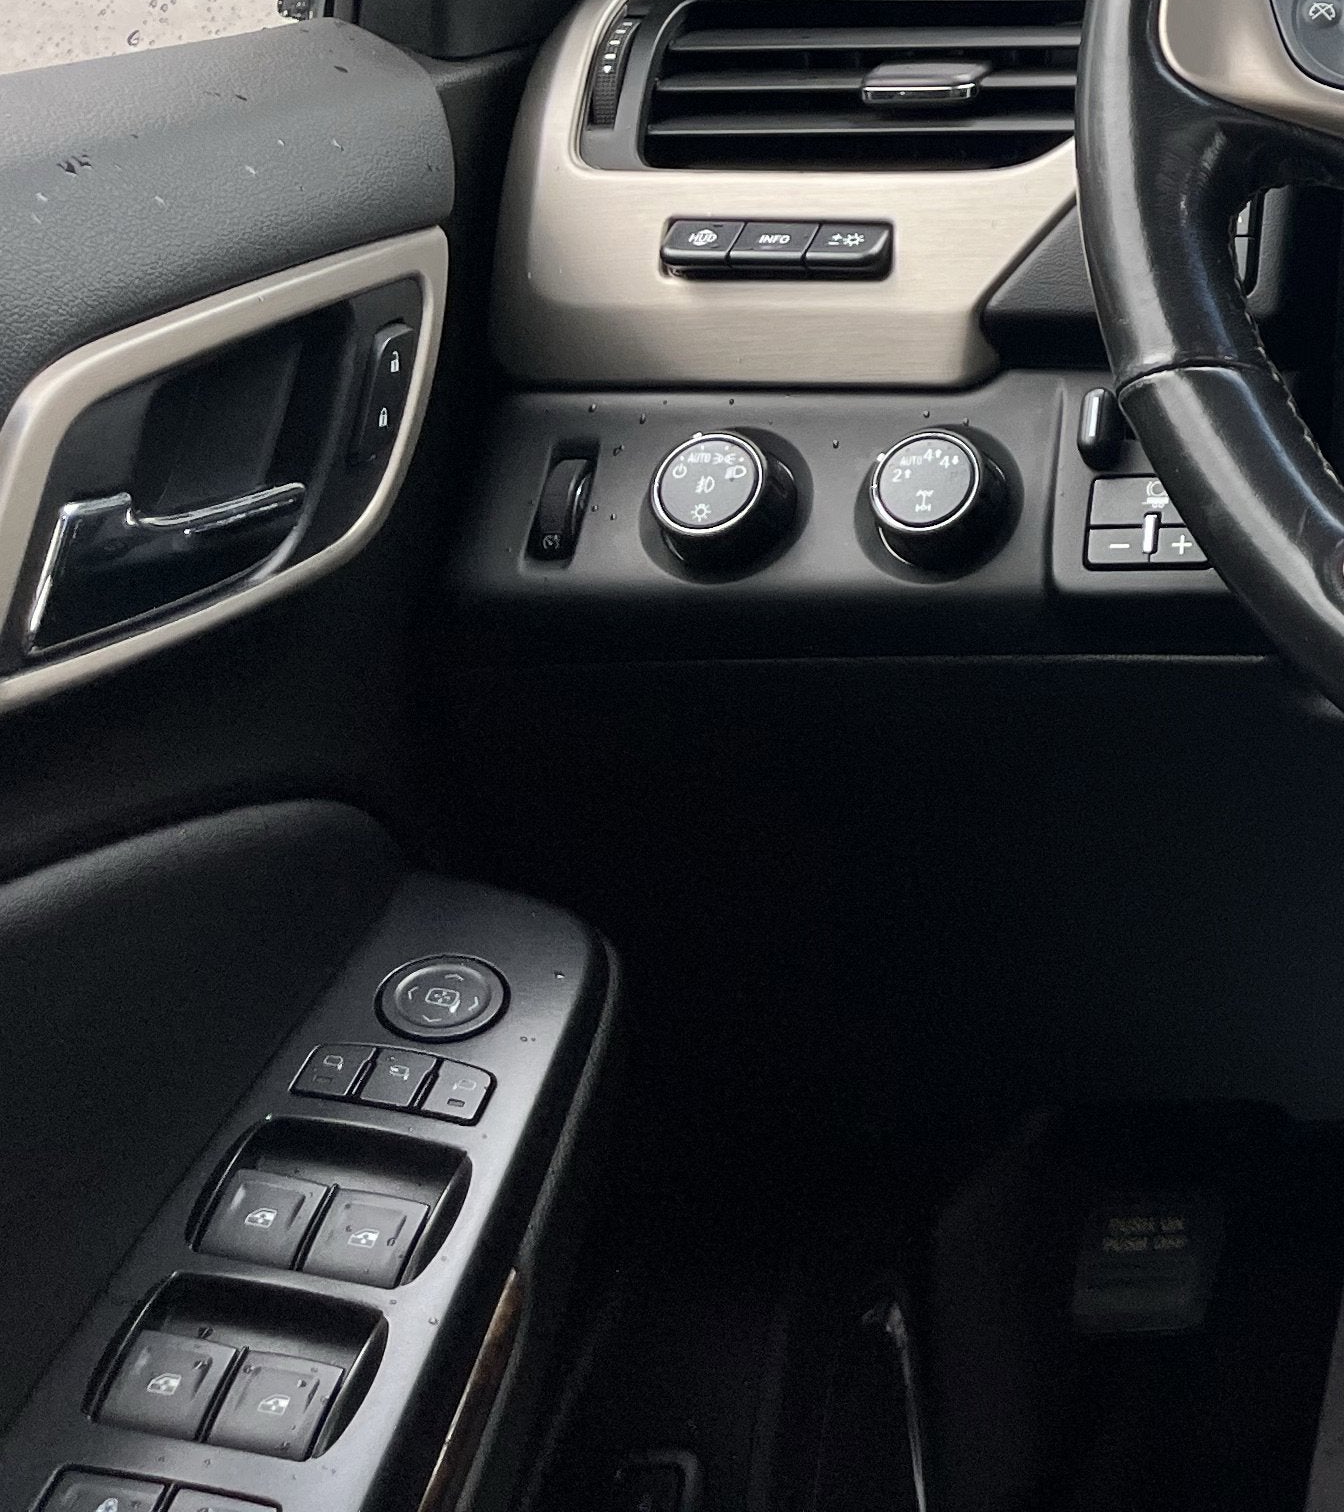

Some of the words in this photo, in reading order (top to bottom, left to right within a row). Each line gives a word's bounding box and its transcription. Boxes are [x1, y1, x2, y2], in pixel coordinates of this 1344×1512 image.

[688, 231, 718, 245] HUD
[758, 234, 791, 245] INFO
[687, 451, 712, 464] AUTO
[899, 455, 923, 466] AUTO
